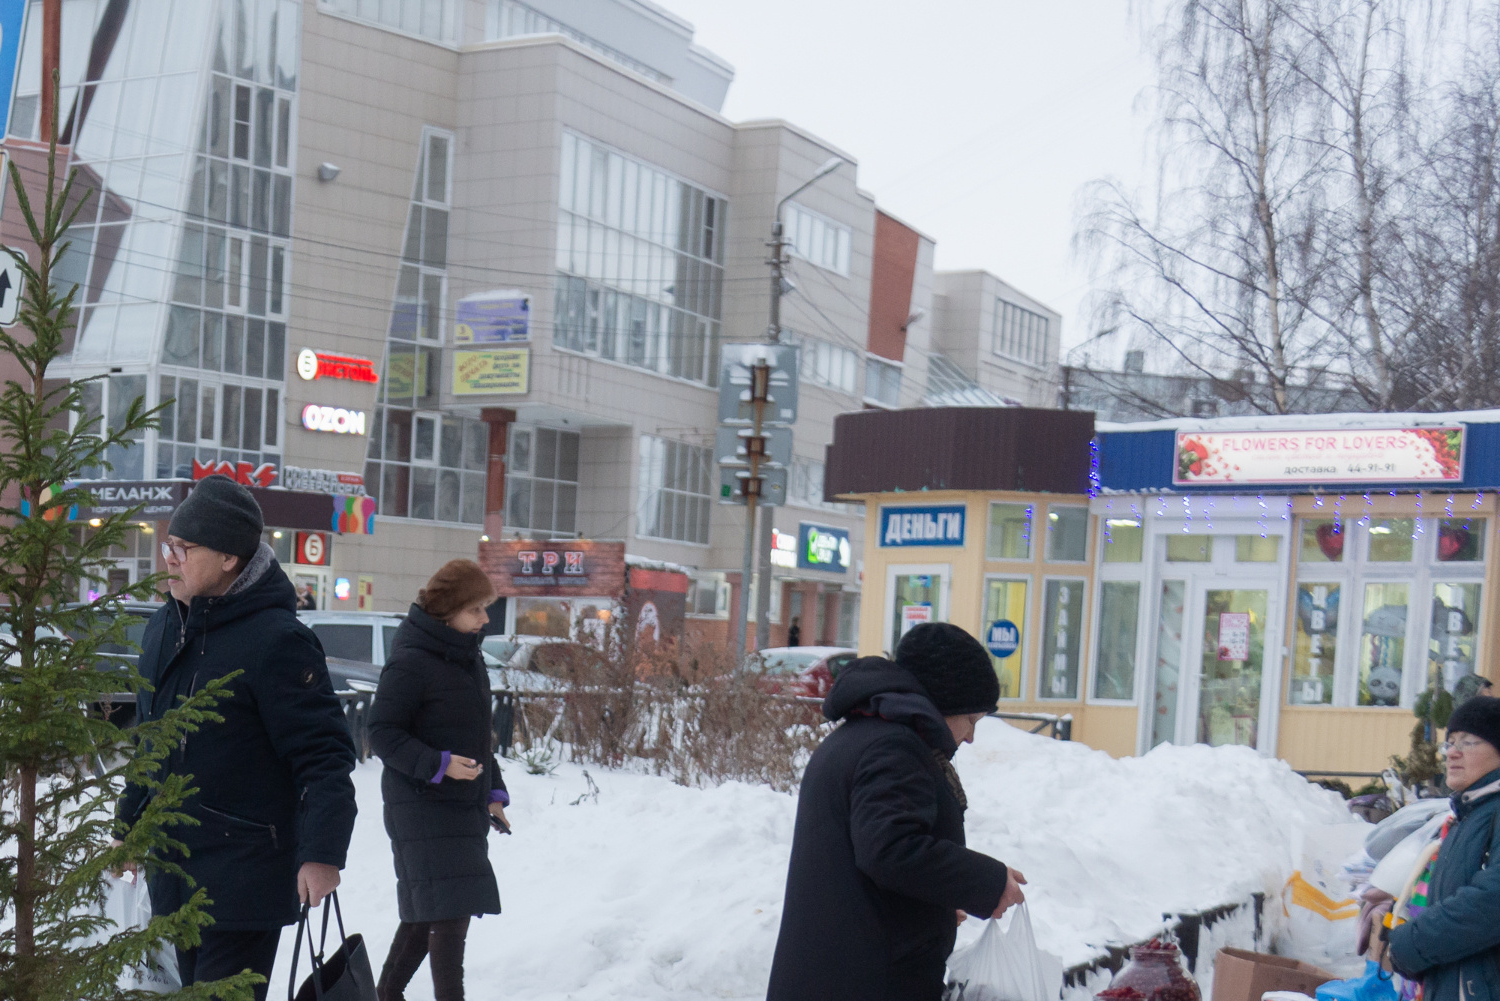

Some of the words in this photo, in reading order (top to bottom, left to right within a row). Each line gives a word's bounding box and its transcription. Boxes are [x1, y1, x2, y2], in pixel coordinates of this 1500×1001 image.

[297, 349, 379, 384] Бристоль
[302, 404, 365, 435] OZON
[1222, 437, 1300, 452] FLOWERS
[1305, 436, 1337, 450] FOR
[1343, 435, 1408, 450] LOVERS
[1284, 465, 1337, 475] доставка
[90, 486, 174, 501] МЕЛАНЖ
[885, 512, 961, 544] ДЕНЬГИ
[518, 551, 585, 574] ТРИ
[991, 627, 1016, 641] МЫ
[1302, 585, 1329, 703] ЦВЕТЫ
